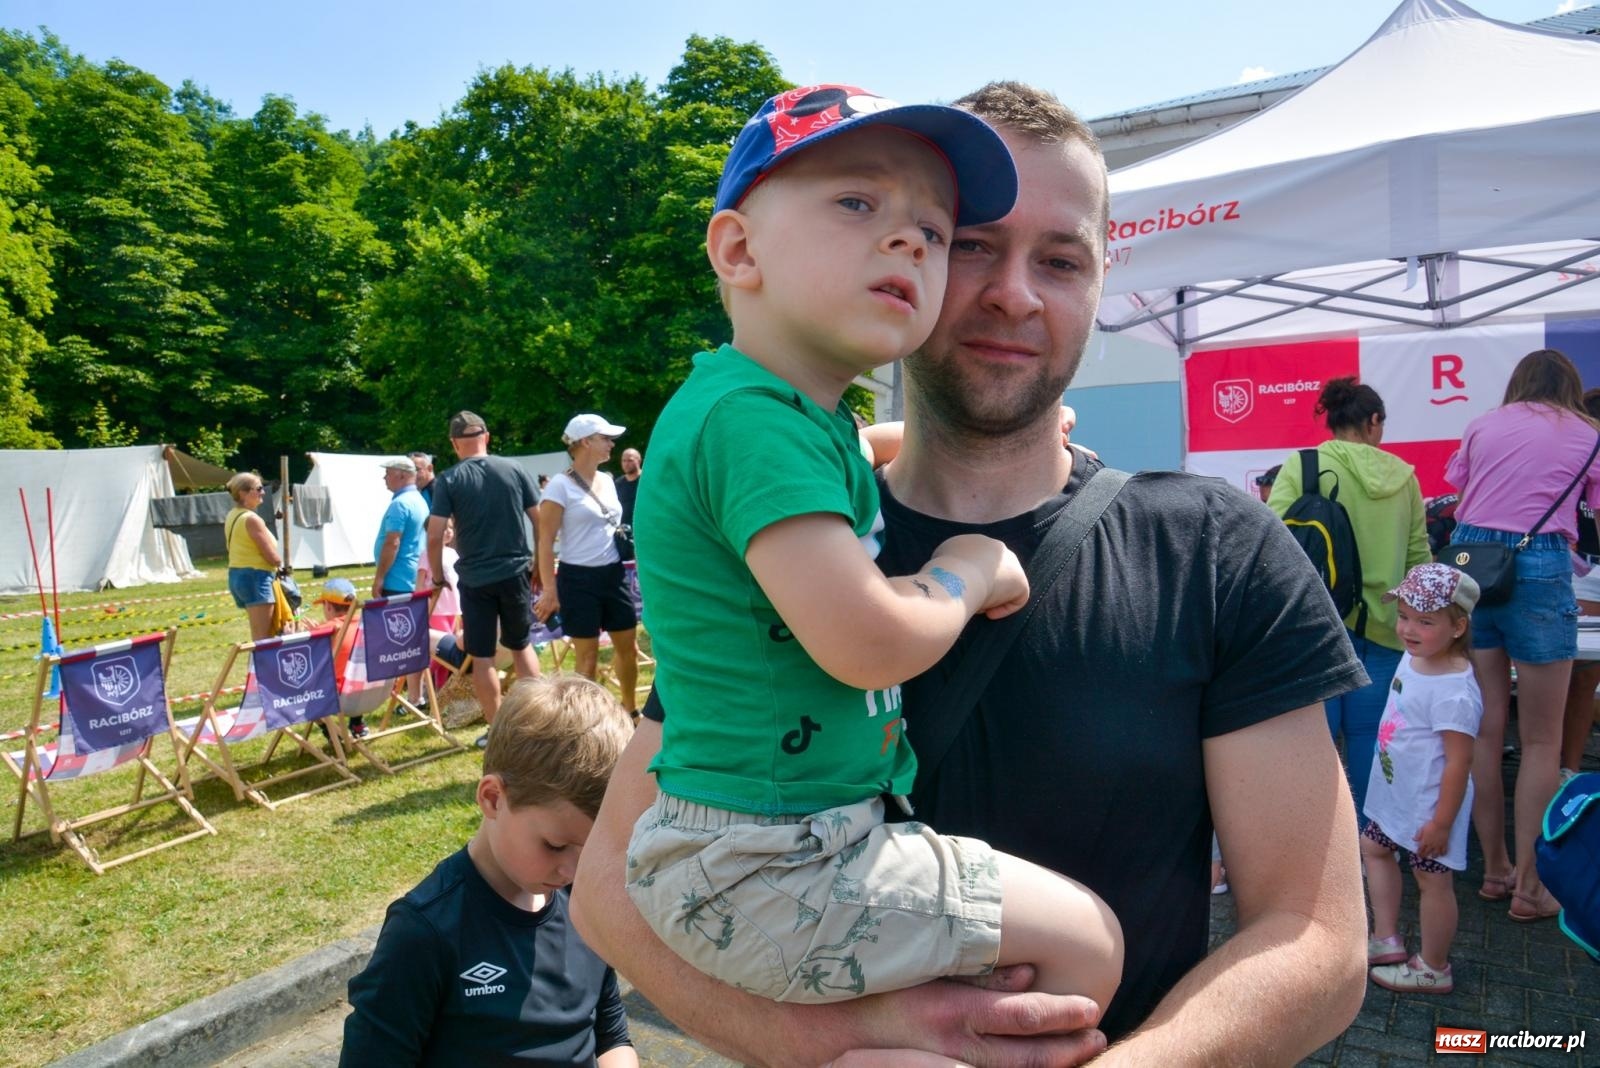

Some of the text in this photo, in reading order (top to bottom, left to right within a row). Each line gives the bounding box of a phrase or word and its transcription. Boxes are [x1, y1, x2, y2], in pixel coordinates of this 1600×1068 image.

[1432, 354, 1465, 390] R
[1258, 379, 1321, 395] RACIBÓRZ
[273, 688, 325, 709] RACIBÓRZ
[88, 704, 154, 730] RACIBÓRZ
[464, 983, 506, 997] umbro
